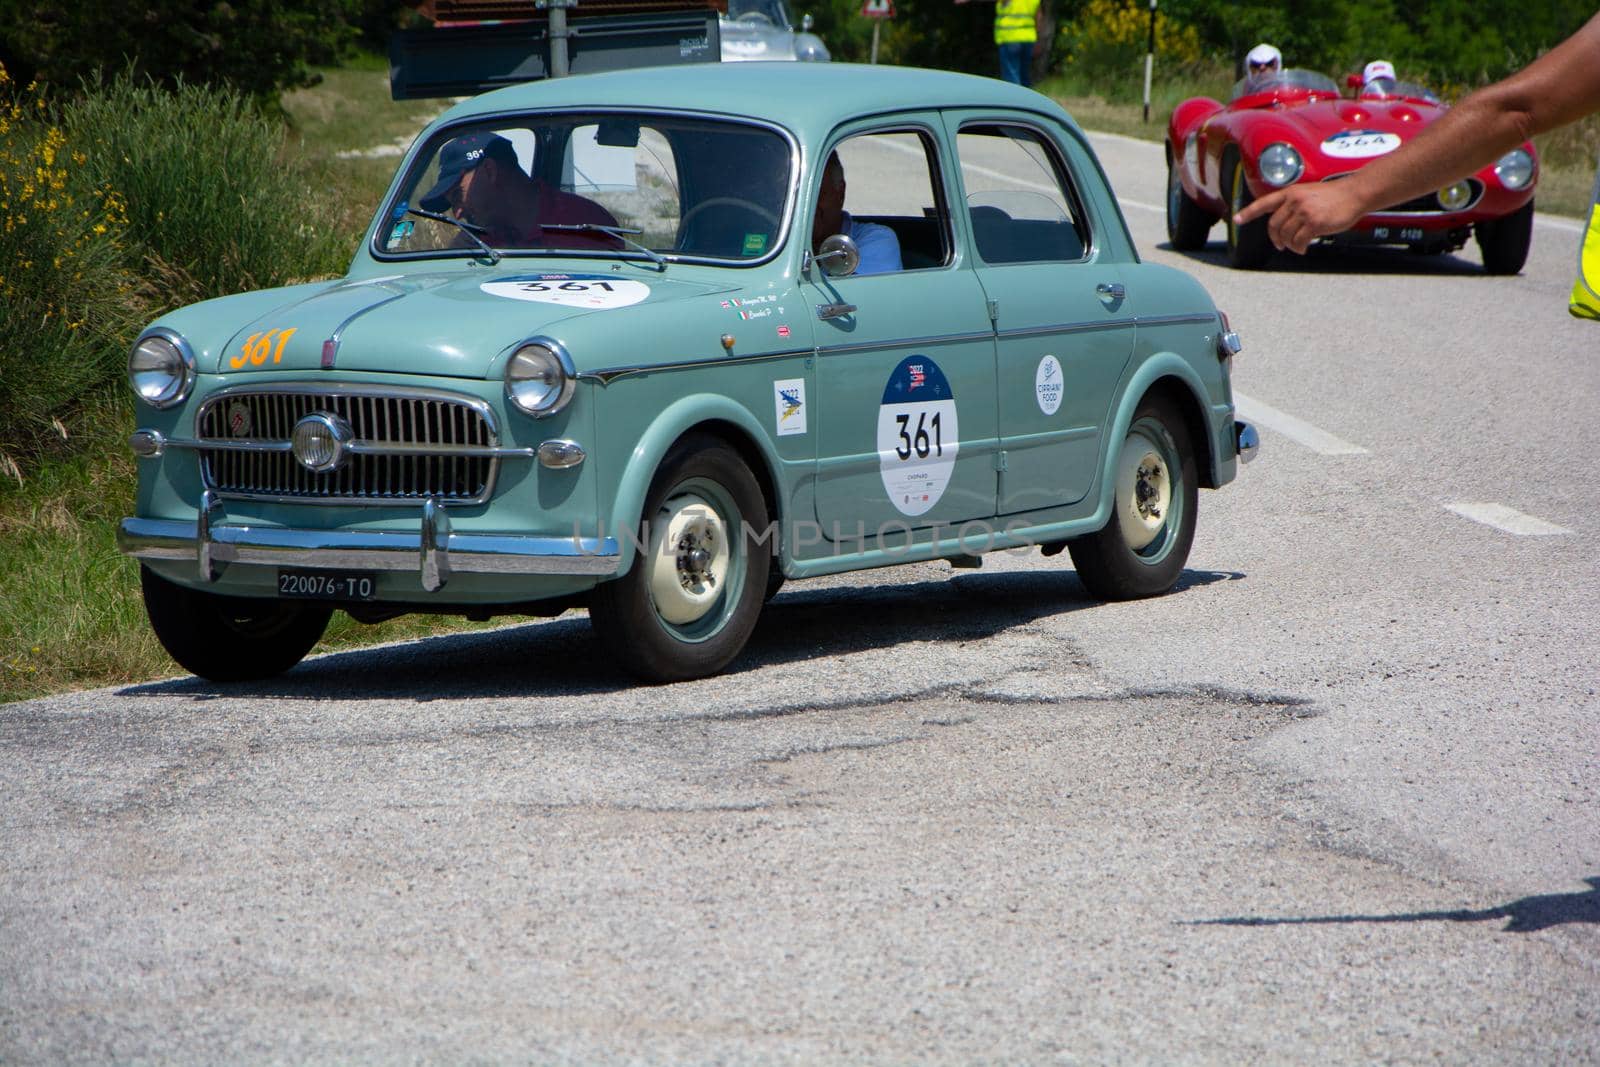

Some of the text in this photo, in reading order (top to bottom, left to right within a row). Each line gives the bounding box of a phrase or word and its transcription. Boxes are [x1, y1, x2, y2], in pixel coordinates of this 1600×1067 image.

[466, 149, 485, 160] 361
[517, 281, 615, 292] 361
[229, 327, 298, 369] 361
[1043, 393, 1057, 401] FOOD
[896, 411, 942, 461] 361
[280, 575, 371, 597] 220076 TO
